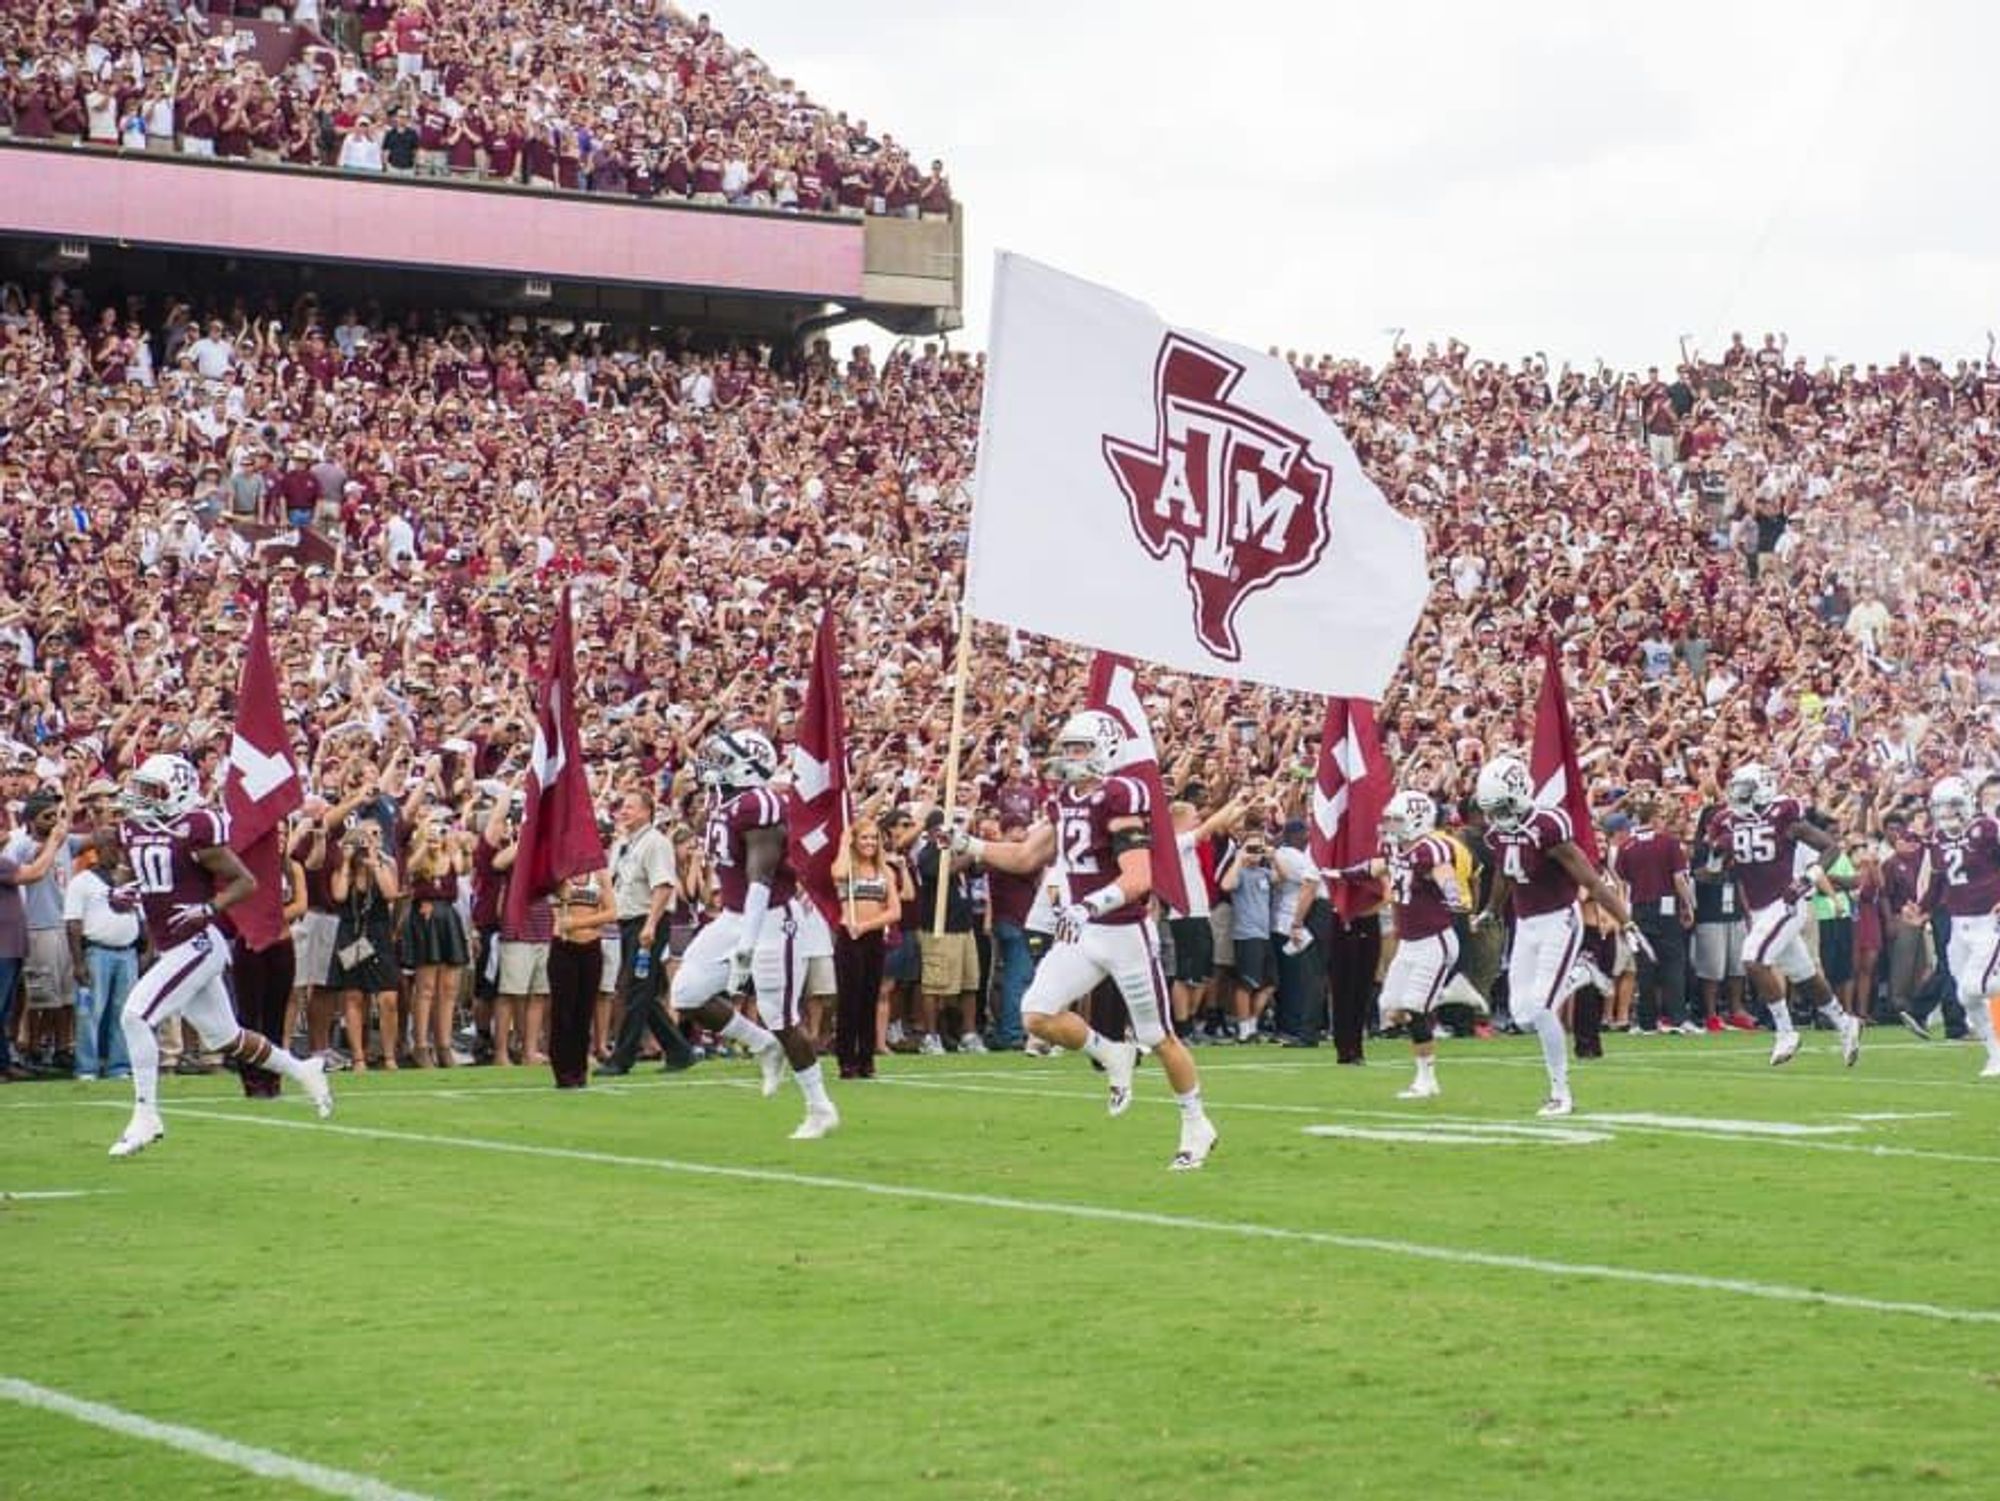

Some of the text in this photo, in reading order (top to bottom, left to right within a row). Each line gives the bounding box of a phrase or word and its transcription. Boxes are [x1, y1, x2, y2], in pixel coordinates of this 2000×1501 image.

[1733, 826, 1777, 863] 95
[129, 846, 174, 893] 10
[1503, 845, 1530, 884] 4
[1943, 850, 1968, 885] 2
